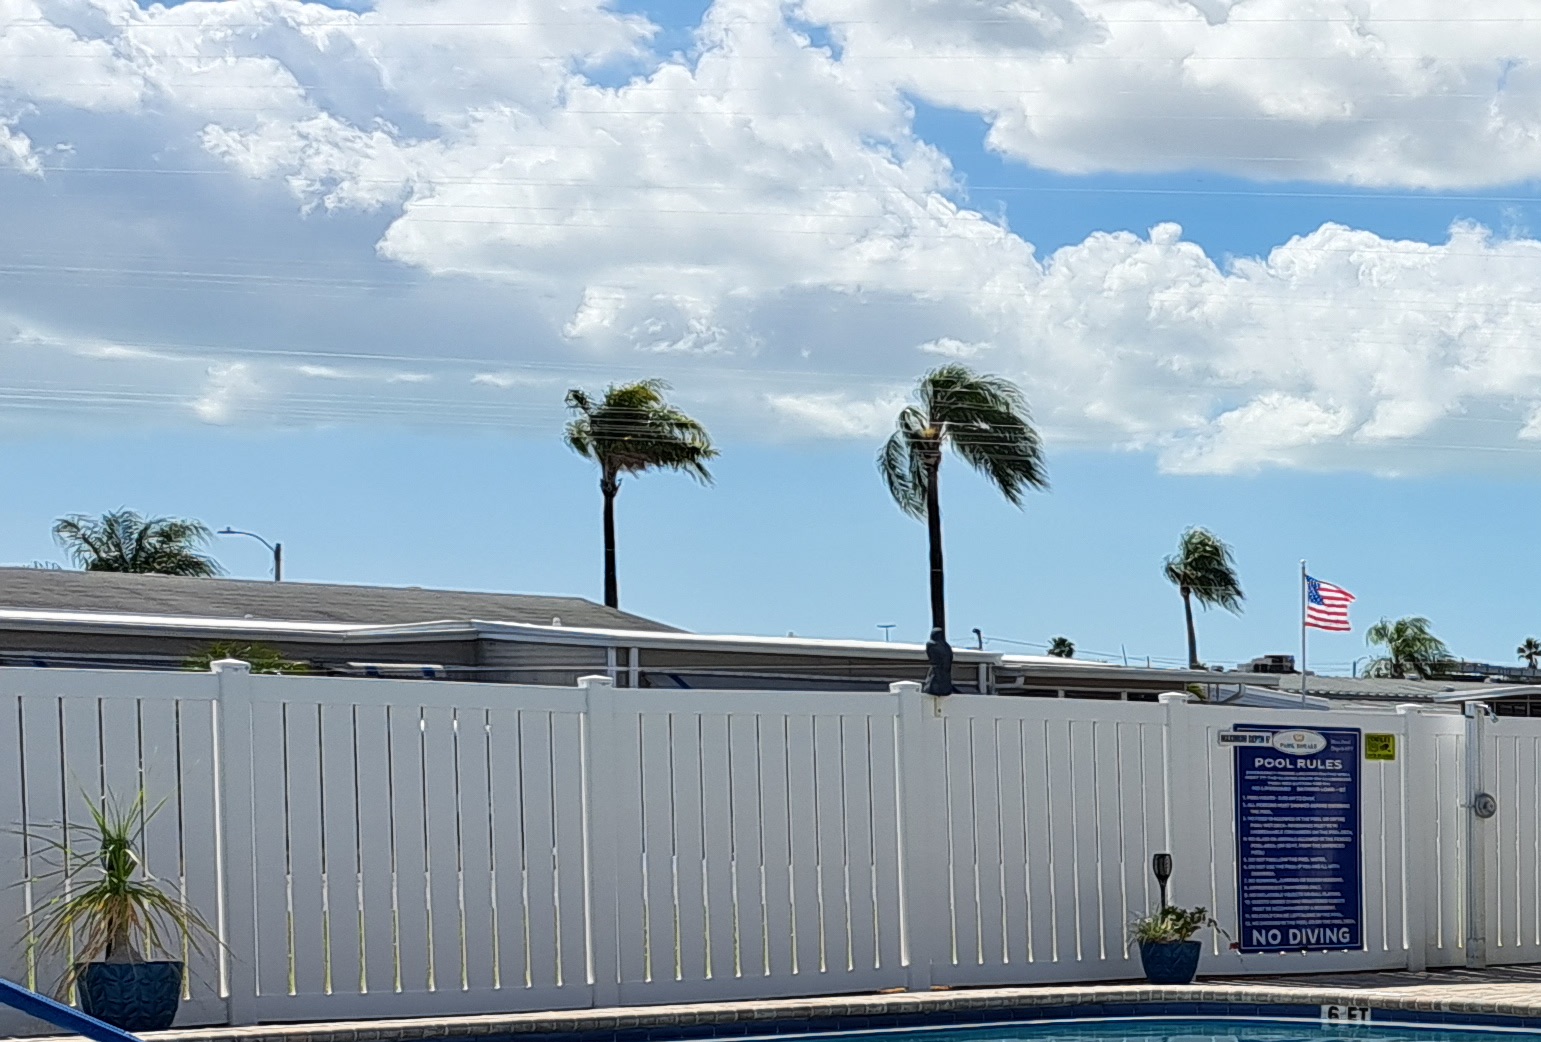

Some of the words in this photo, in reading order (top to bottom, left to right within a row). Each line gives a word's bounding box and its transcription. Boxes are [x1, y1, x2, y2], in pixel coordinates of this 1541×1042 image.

[1254, 757, 1294, 769] POOL
[1296, 758, 1343, 770] RULES
[1252, 928, 1282, 946] NO
[1288, 927, 1351, 945] DIVING
[1328, 1005, 1340, 1020] 6
[1347, 1006, 1369, 1021] FT
